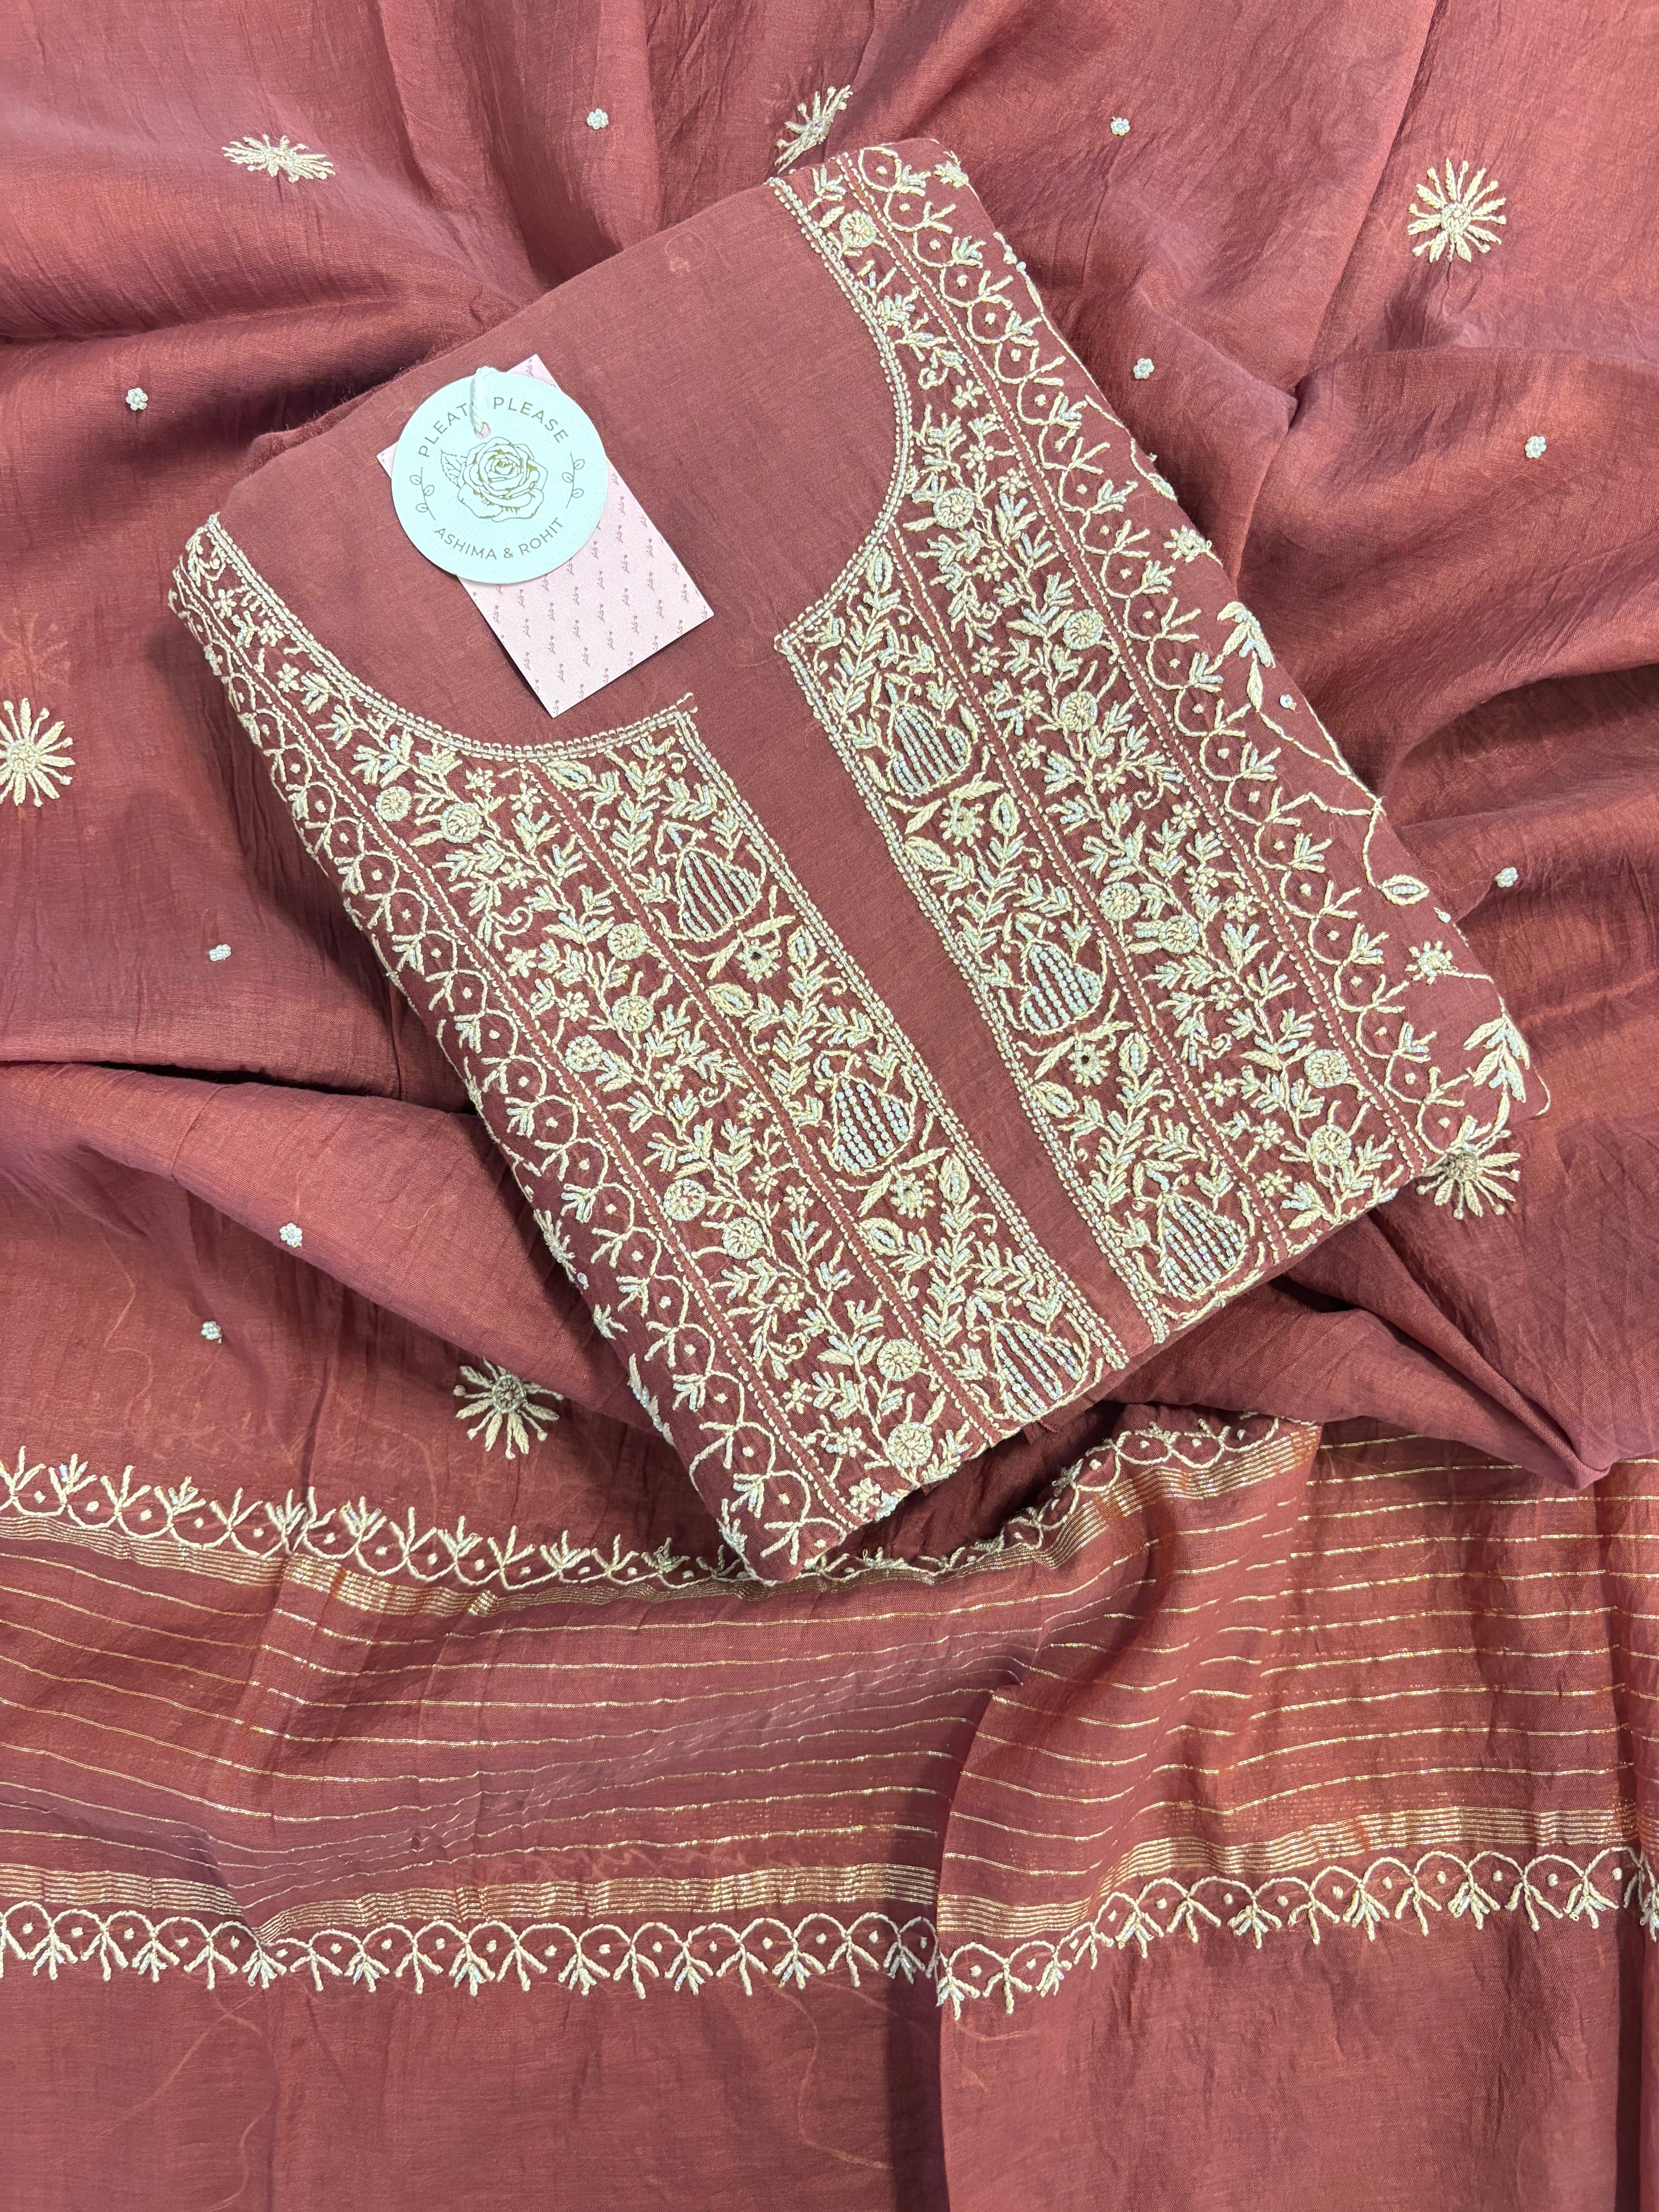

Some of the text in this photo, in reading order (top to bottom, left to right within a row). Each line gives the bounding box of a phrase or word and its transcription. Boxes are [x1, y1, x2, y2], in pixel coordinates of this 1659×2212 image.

[418, 397, 568, 458] PLEAT PLEASE
[434, 517, 563, 560] ASHIMA & ROHIT
